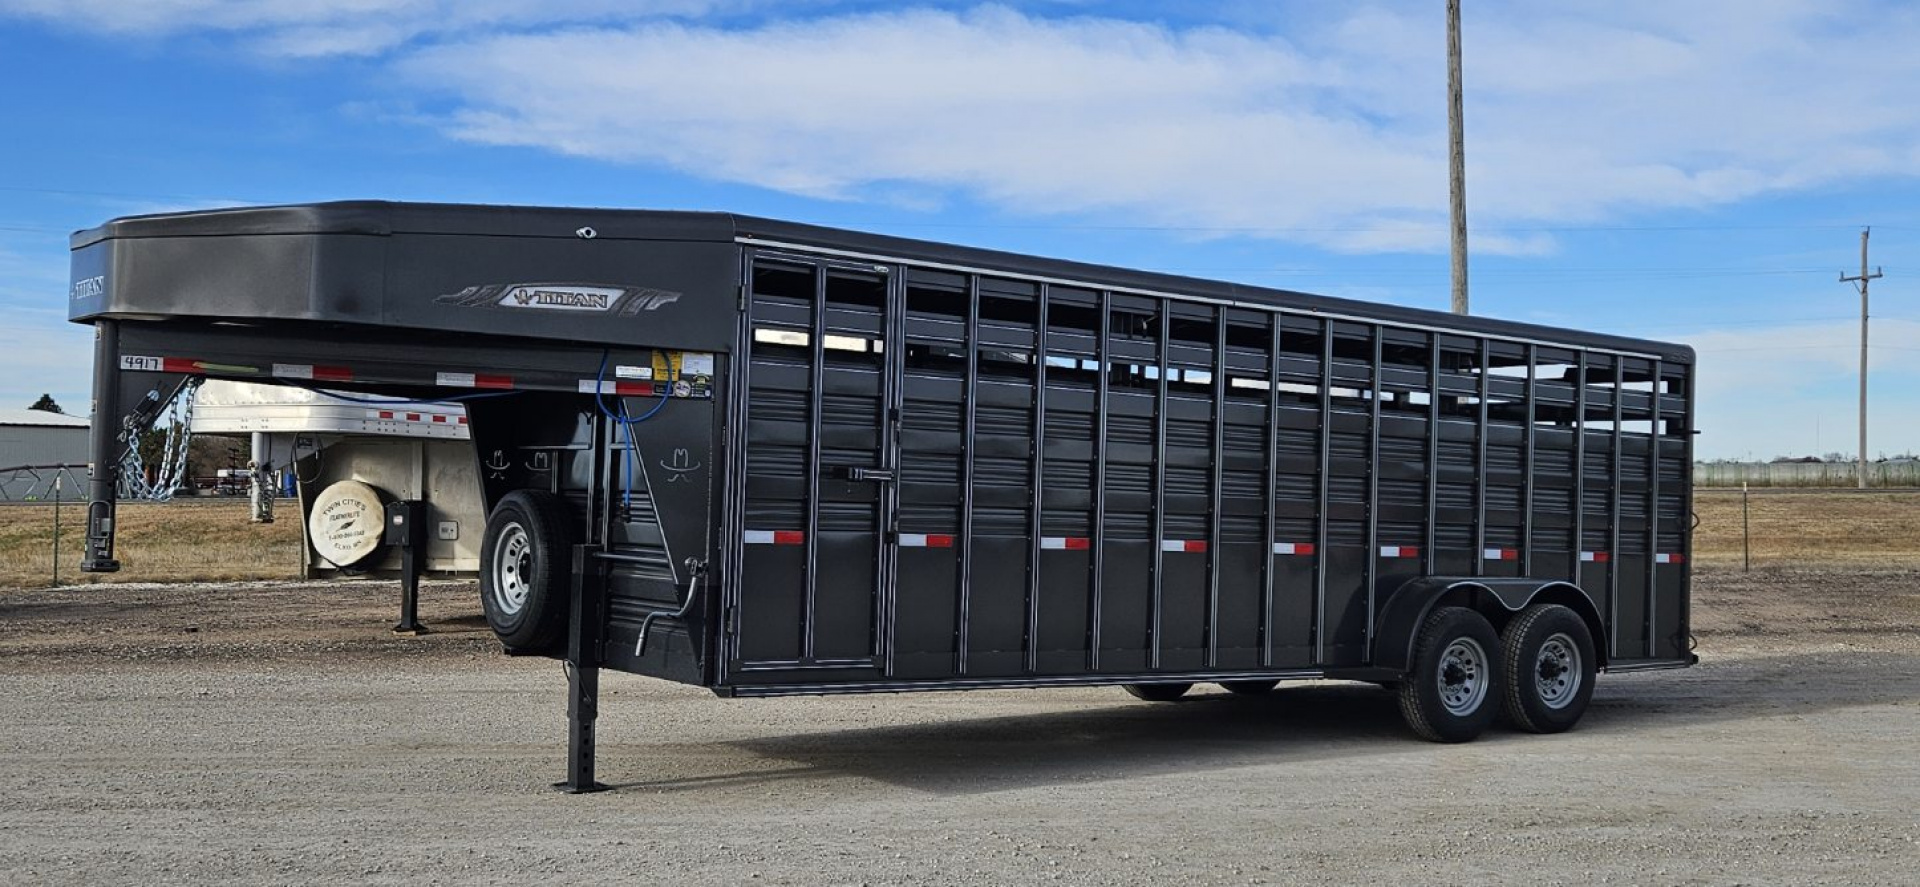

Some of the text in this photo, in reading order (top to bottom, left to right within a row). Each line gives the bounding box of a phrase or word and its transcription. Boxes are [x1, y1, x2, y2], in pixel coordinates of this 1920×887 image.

[76, 276, 104, 299] TITAN
[534, 291, 608, 308] TITAN
[126, 357, 158, 369] 4917
[323, 499, 366, 514] TWIN CITIES
